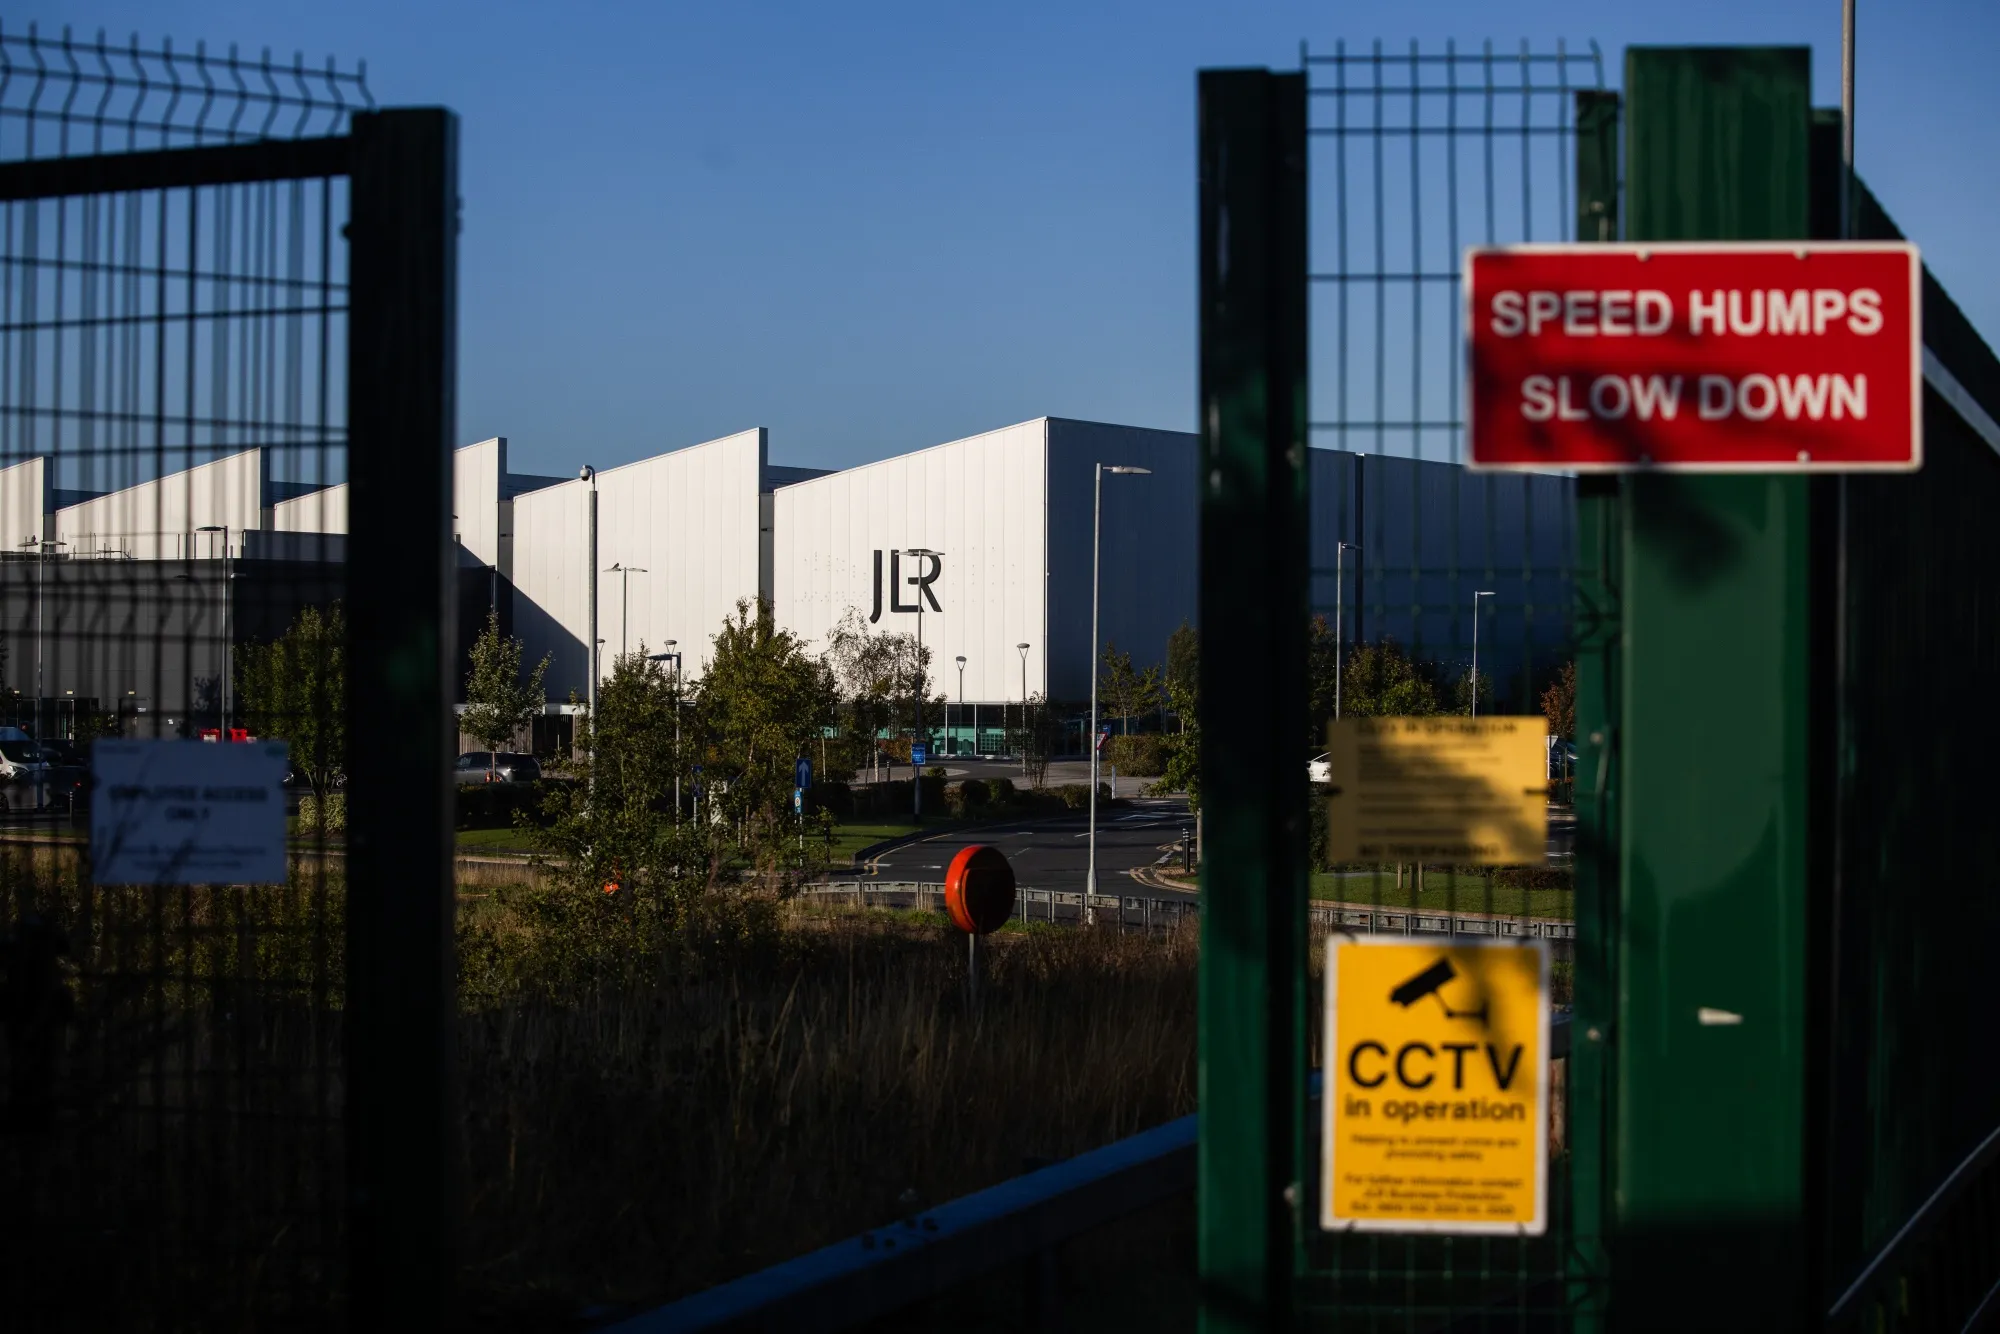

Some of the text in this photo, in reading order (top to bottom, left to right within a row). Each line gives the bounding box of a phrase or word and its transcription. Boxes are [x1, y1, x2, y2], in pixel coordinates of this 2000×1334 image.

[1491, 289, 1884, 336] SPEED HUMPS
[1521, 374, 1867, 420] SLOW DOWN
[869, 549, 943, 624] JLR
[1347, 1039, 1524, 1091] CCTV
[1345, 1095, 1526, 1125] in operation
